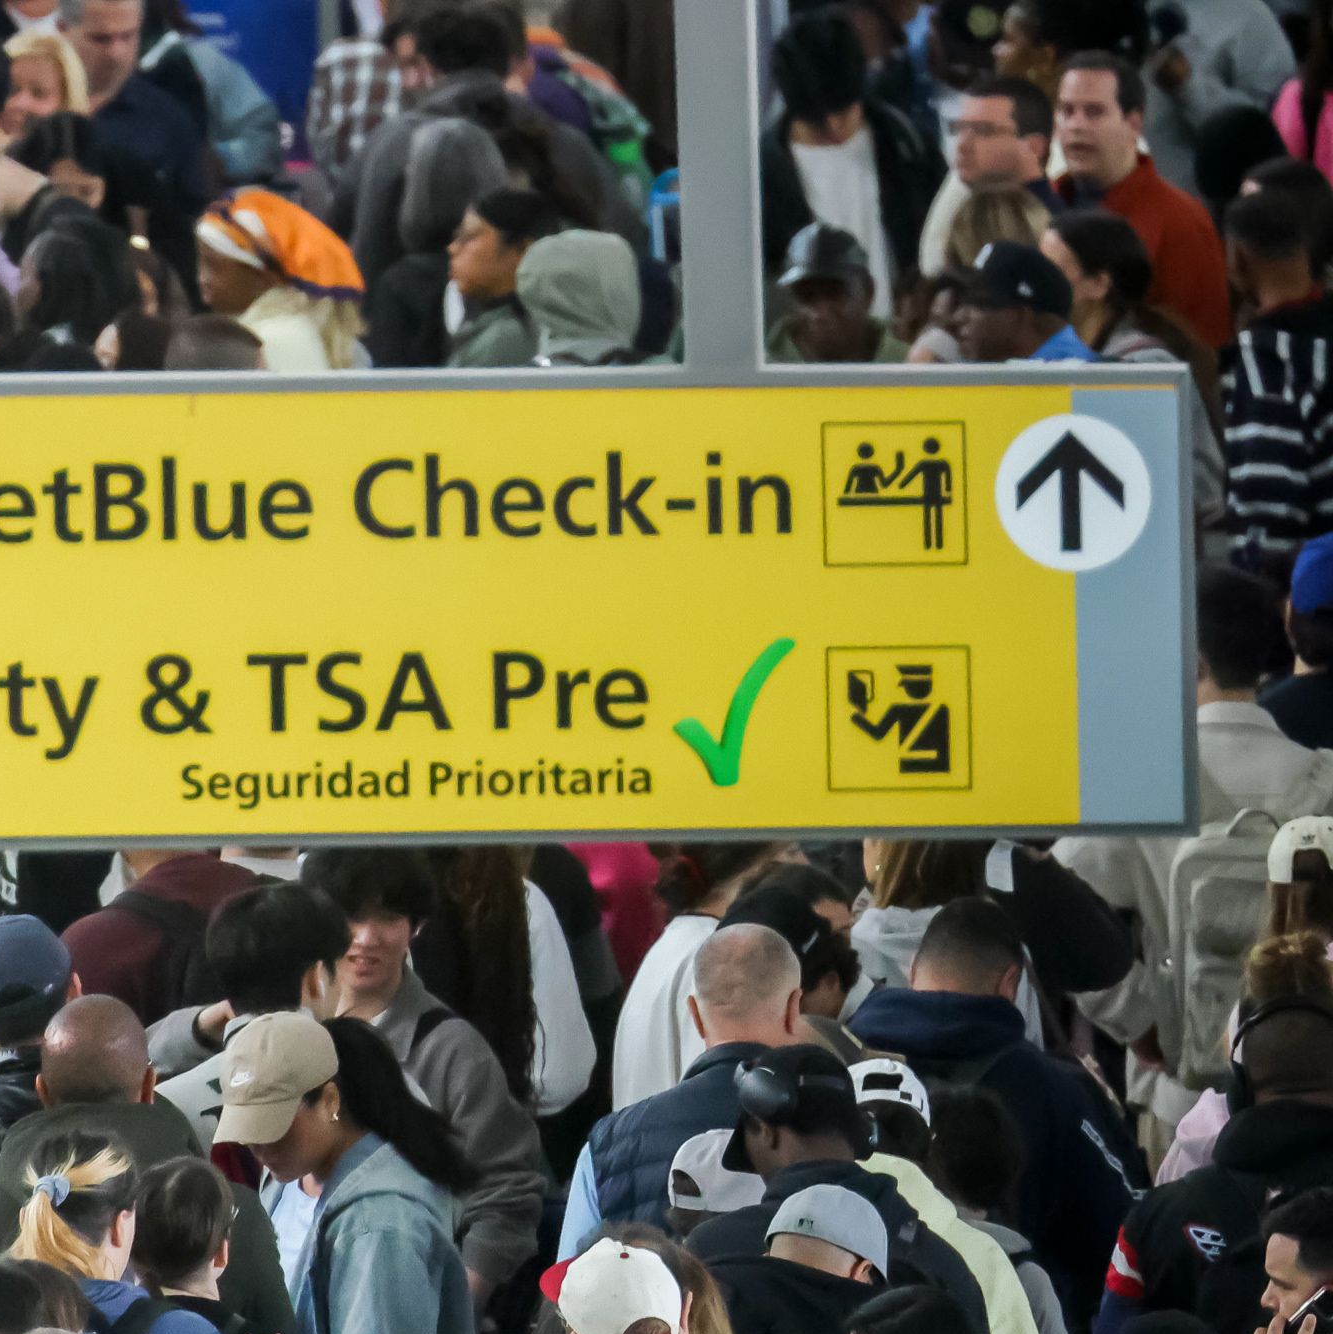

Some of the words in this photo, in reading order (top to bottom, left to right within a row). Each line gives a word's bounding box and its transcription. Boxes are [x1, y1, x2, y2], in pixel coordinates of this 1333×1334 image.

[354, 451, 792, 540] Check-in
[140, 655, 212, 737] &
[247, 650, 450, 733] TSA
[491, 647, 651, 730] Pre
[181, 760, 410, 807] Seguridad
[429, 756, 652, 798] Prioritaria
